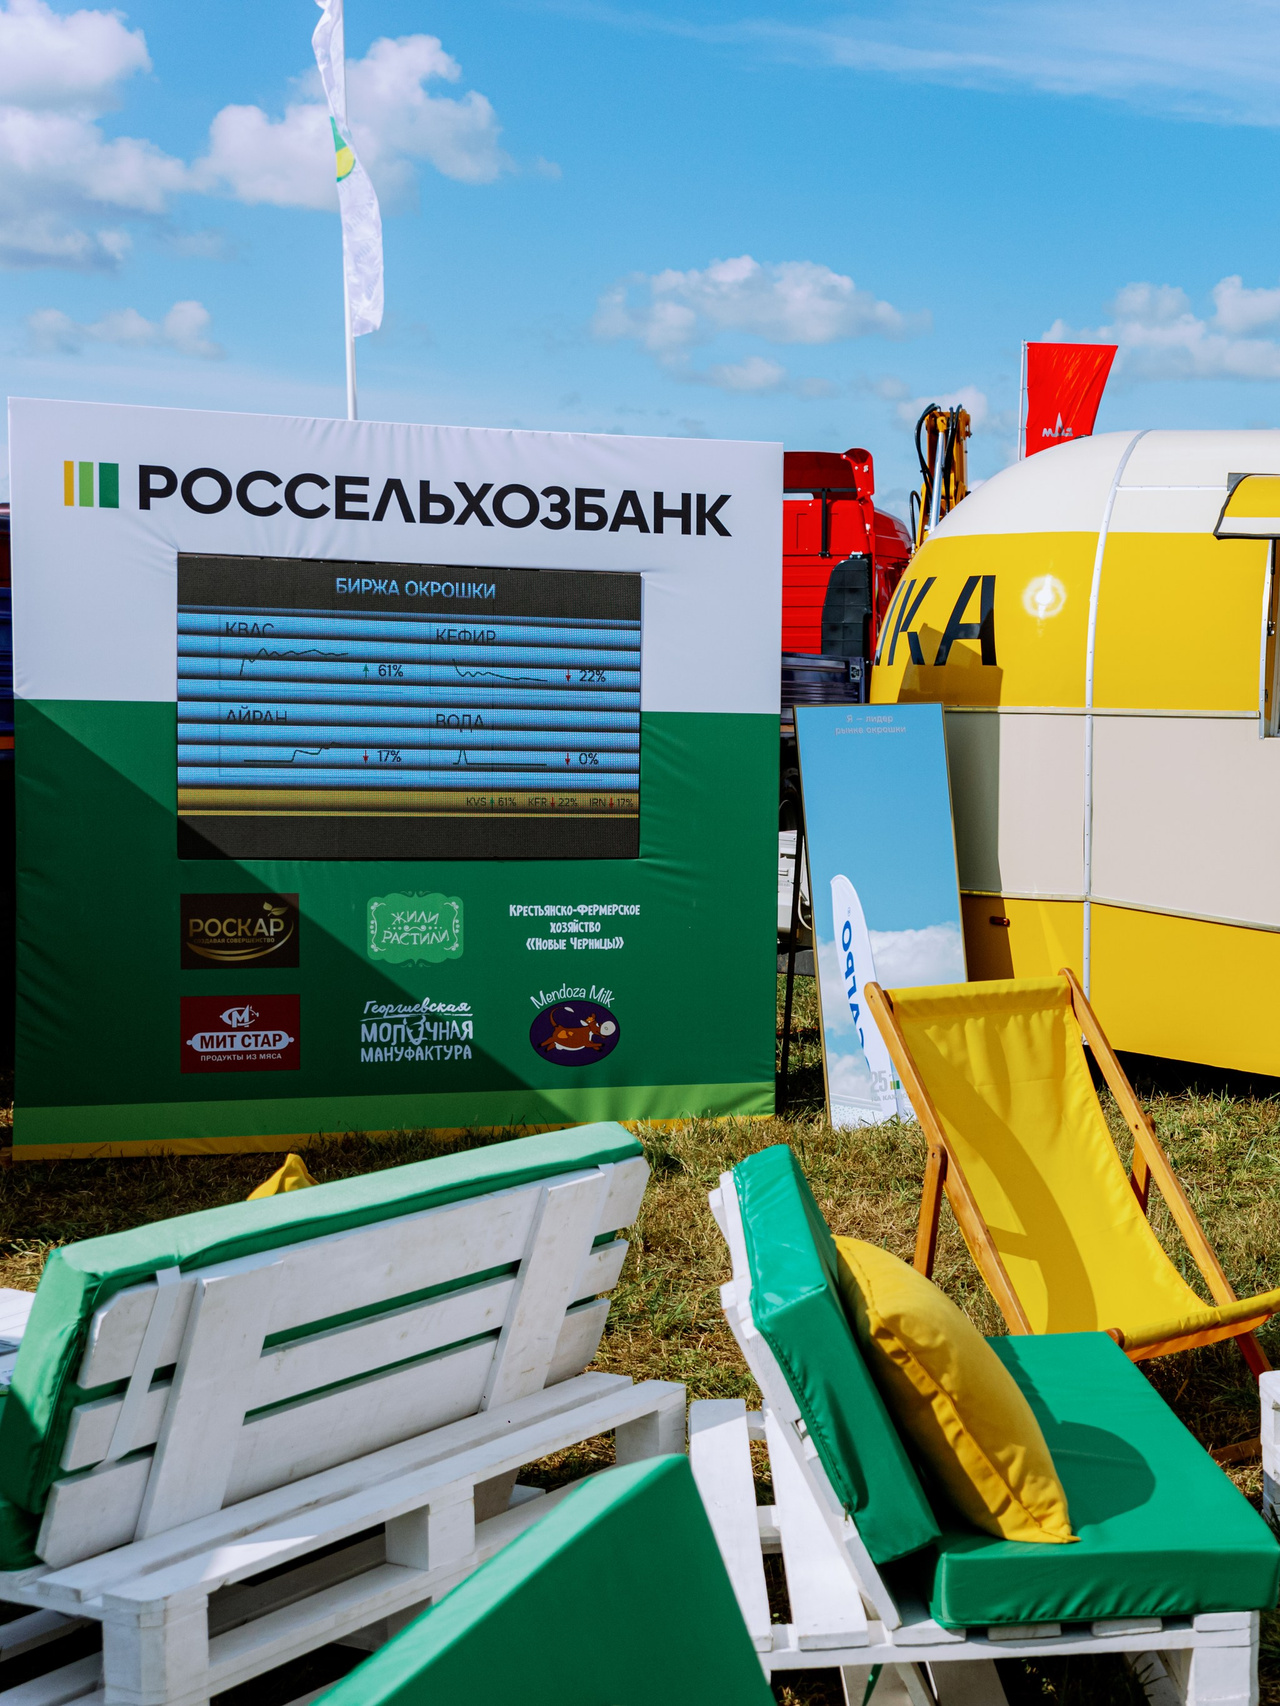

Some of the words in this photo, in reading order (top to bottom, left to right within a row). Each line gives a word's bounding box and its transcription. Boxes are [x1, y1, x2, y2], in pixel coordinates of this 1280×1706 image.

[138, 464, 733, 538] РОССЕЛЬХОЗБАНК
[335, 577, 400, 597] БИРЖА
[405, 579, 497, 600] ОКРОШКИ
[377, 664, 404, 678] 61%
[578, 669, 607, 684] 22%
[376, 750, 402, 765] 17%
[578, 752, 600, 766] 0%
[466, 797, 487, 807] KVS
[616, 798, 634, 809] 17%
[391, 910, 440, 925] ЖИЛИ
[188, 917, 285, 938] РОСКАР
[381, 929, 450, 946] РАСТИЛИ
[529, 983, 587, 1010] Mendoza
[589, 984, 616, 1008] Milk
[363, 996, 472, 1016] Георгиевская
[200, 1034, 237, 1049] МИТ
[241, 1033, 283, 1048] СТАР
[200, 1054, 244, 1062] ПРОДУКТЫ
[246, 1053, 257, 1061] ИЗ
[259, 1052, 283, 1061] МЯСА
[360, 1044, 473, 1063] МАНУФАКТУРА
